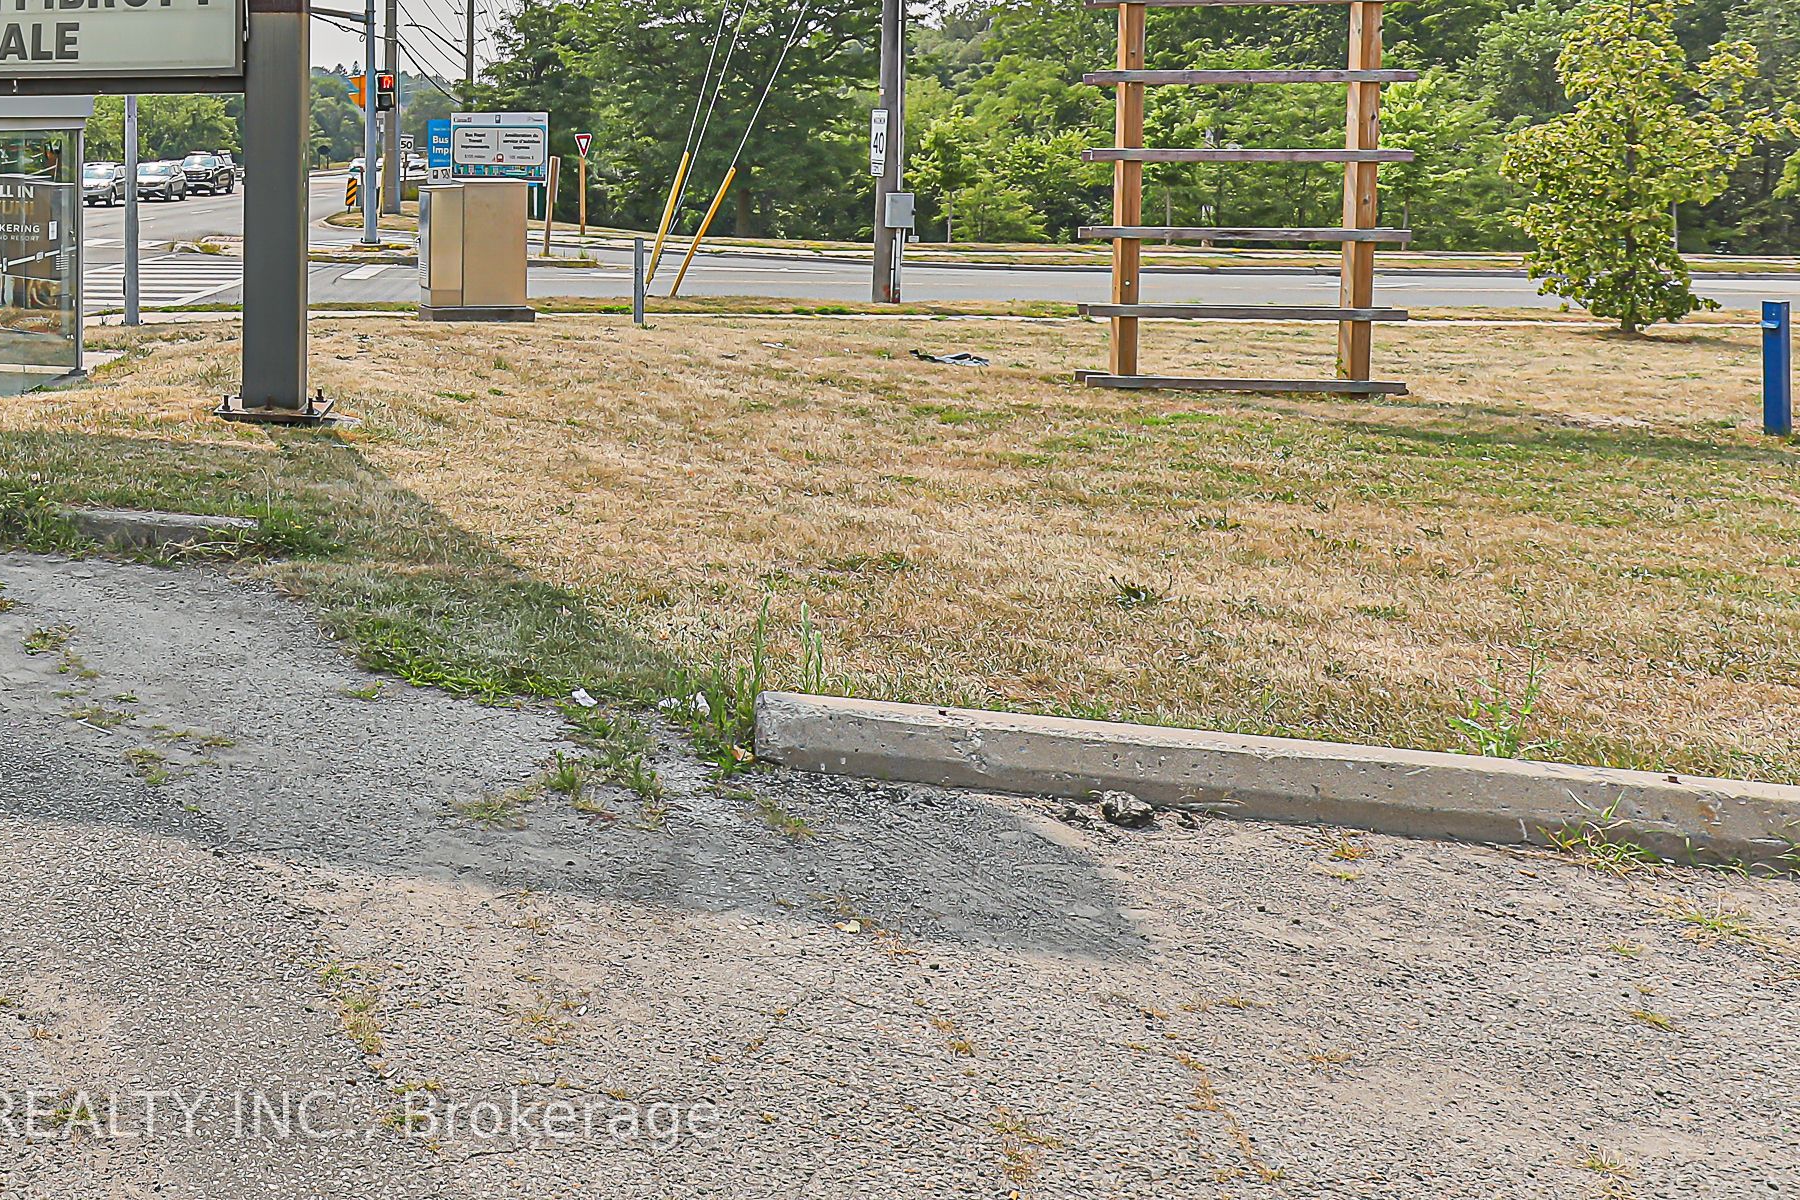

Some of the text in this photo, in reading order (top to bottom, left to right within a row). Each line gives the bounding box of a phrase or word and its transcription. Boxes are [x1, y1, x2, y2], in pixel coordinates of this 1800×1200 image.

[400, 140, 413, 149] 50
[432, 135, 449, 144] Bus
[872, 132, 885, 154] 40
[17, 185, 34, 198] IN
